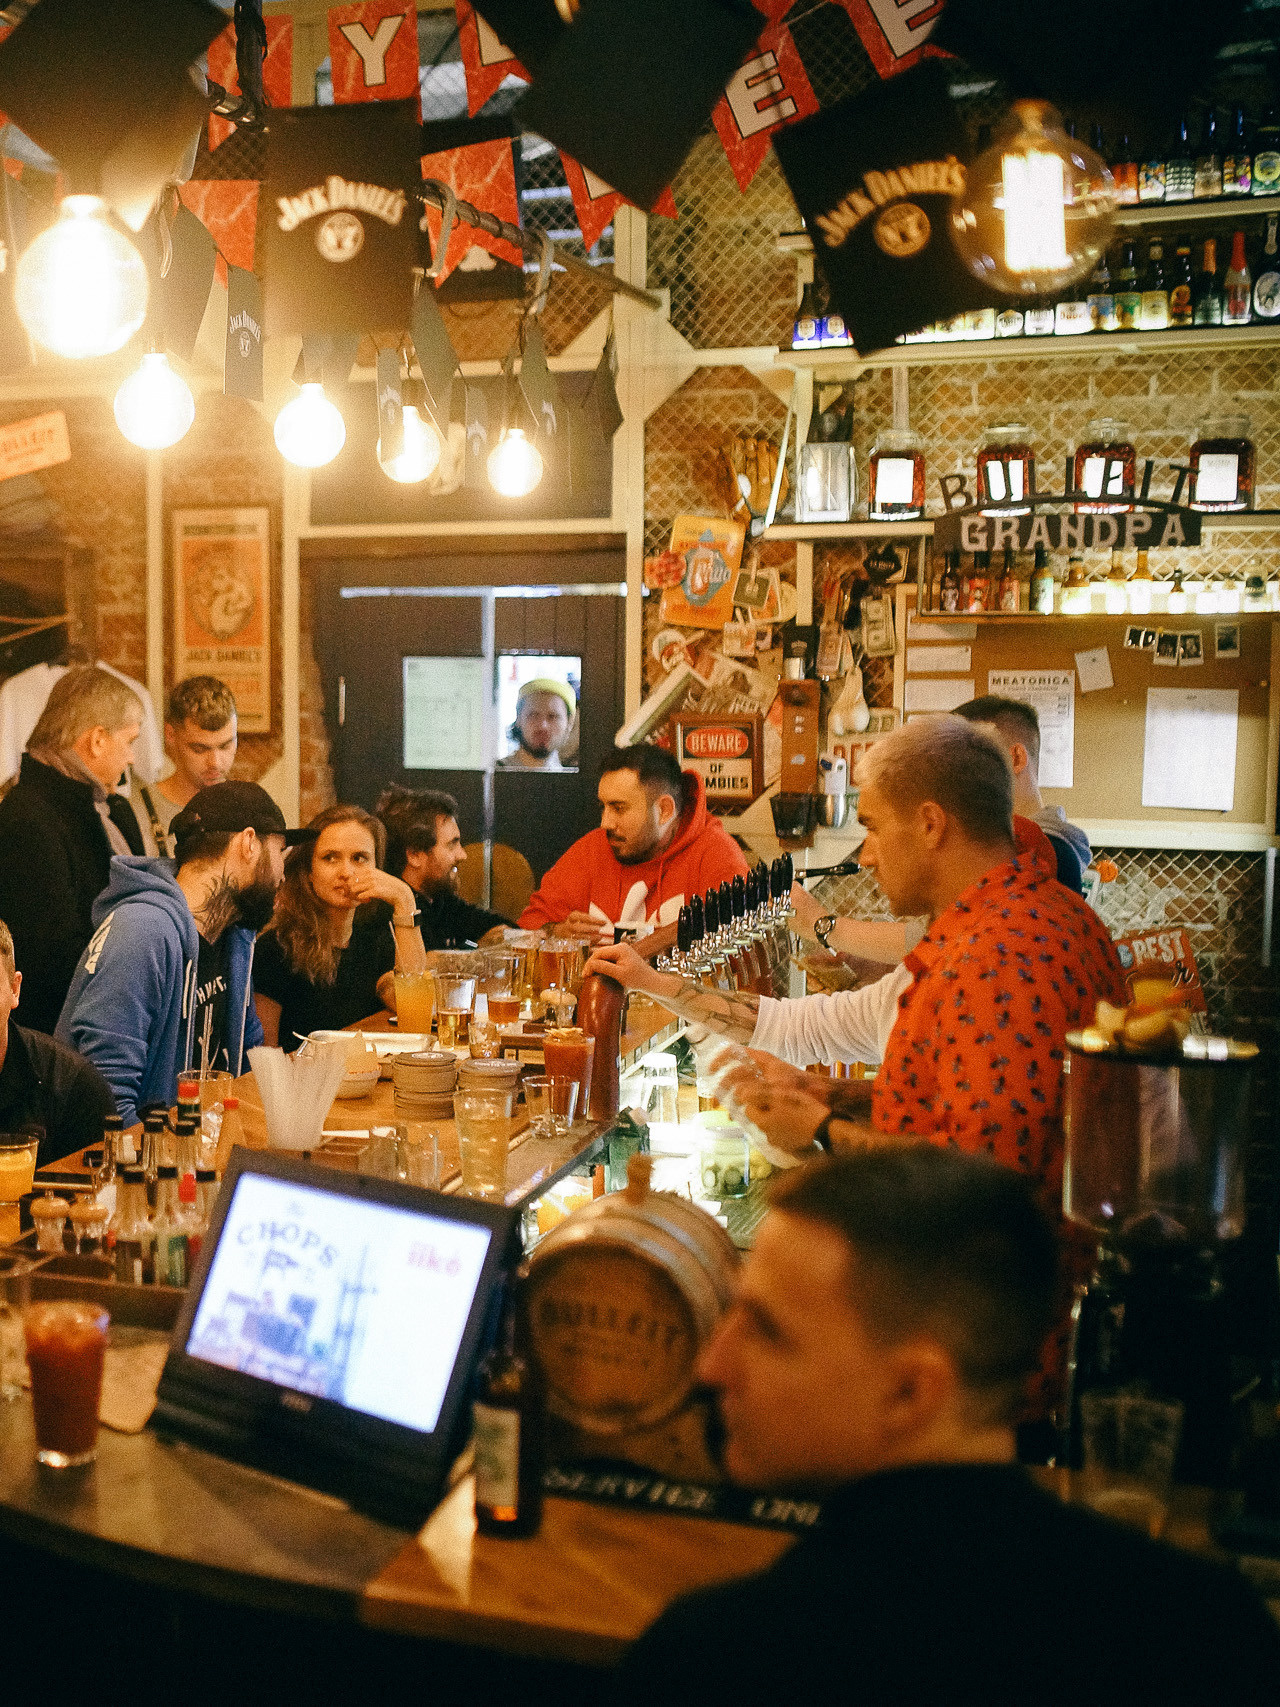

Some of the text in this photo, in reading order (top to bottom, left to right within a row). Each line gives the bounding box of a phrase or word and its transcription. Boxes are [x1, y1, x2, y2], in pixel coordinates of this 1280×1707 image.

[338, 13, 406, 88] Y
[959, 512, 1187, 553] GRANDPA
[691, 731, 744, 754] BEWARE
[704, 775, 749, 789] MBIES
[709, 762, 724, 774] OF
[236, 1219, 339, 1269] CHOPS
